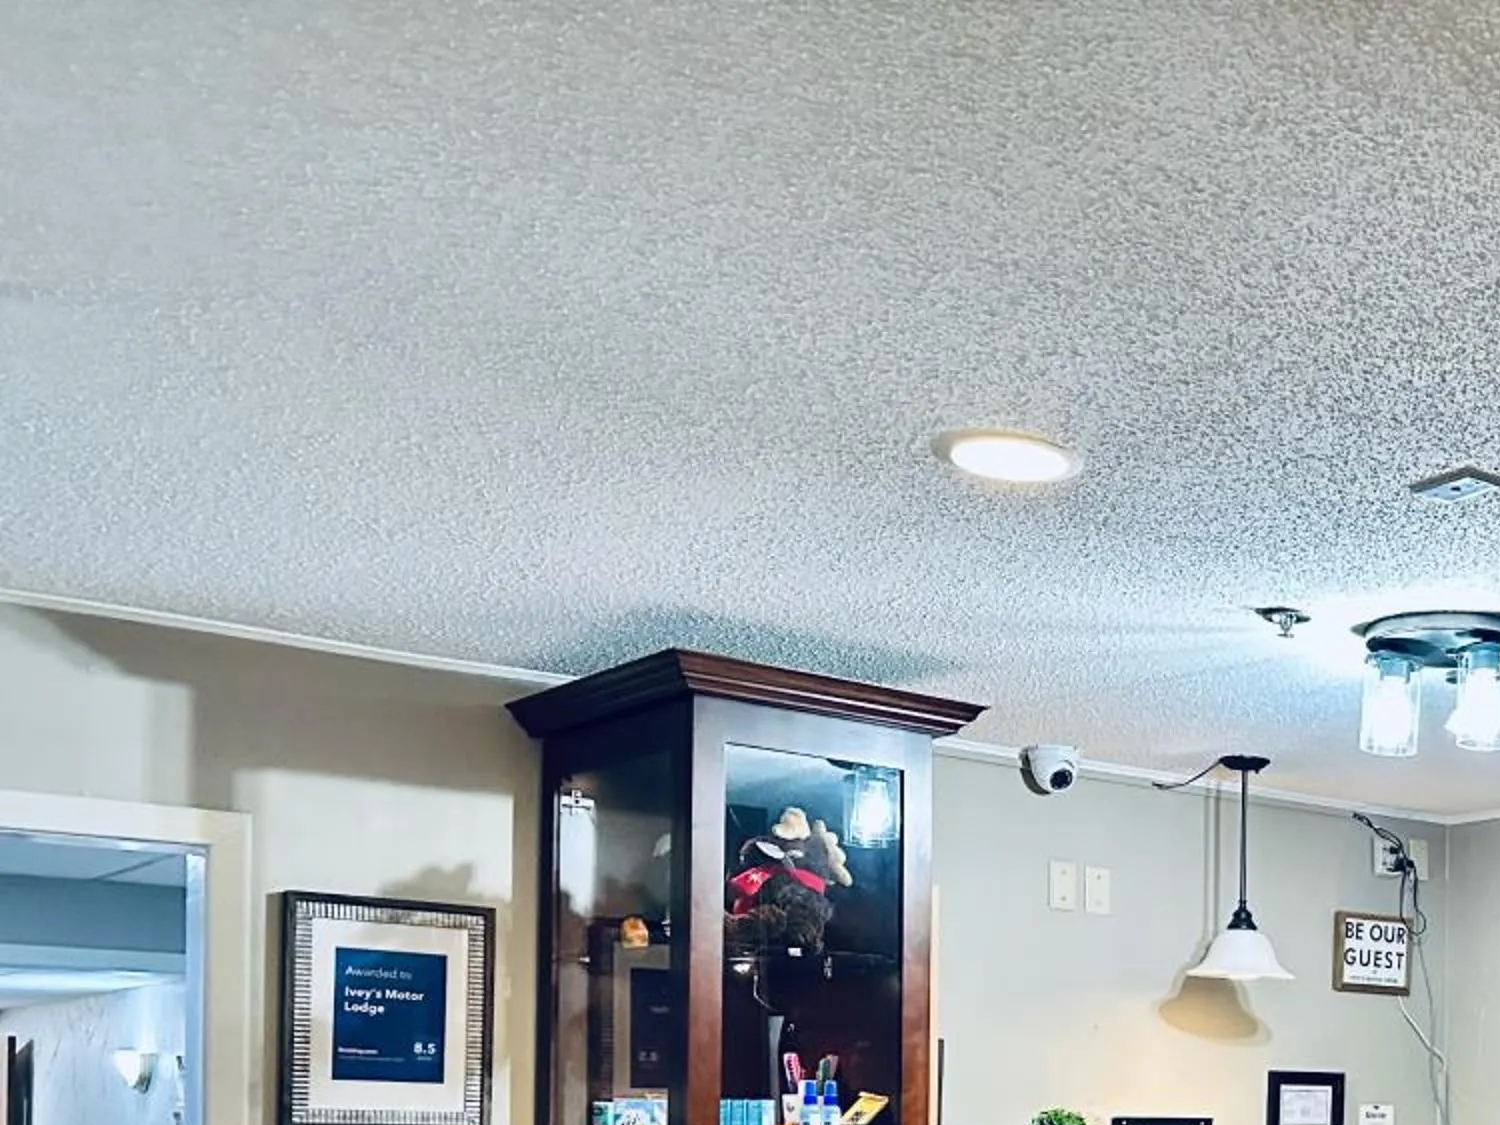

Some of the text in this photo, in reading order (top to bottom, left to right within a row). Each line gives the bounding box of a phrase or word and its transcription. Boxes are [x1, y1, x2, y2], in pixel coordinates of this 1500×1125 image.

[1345, 921, 1406, 945] BE OUR
[1344, 947, 1405, 971] GUEST
[345, 987, 424, 1000] Ivey's Motor
[344, 1002, 384, 1016] Lodge
[413, 1041, 437, 1055] 8.5
